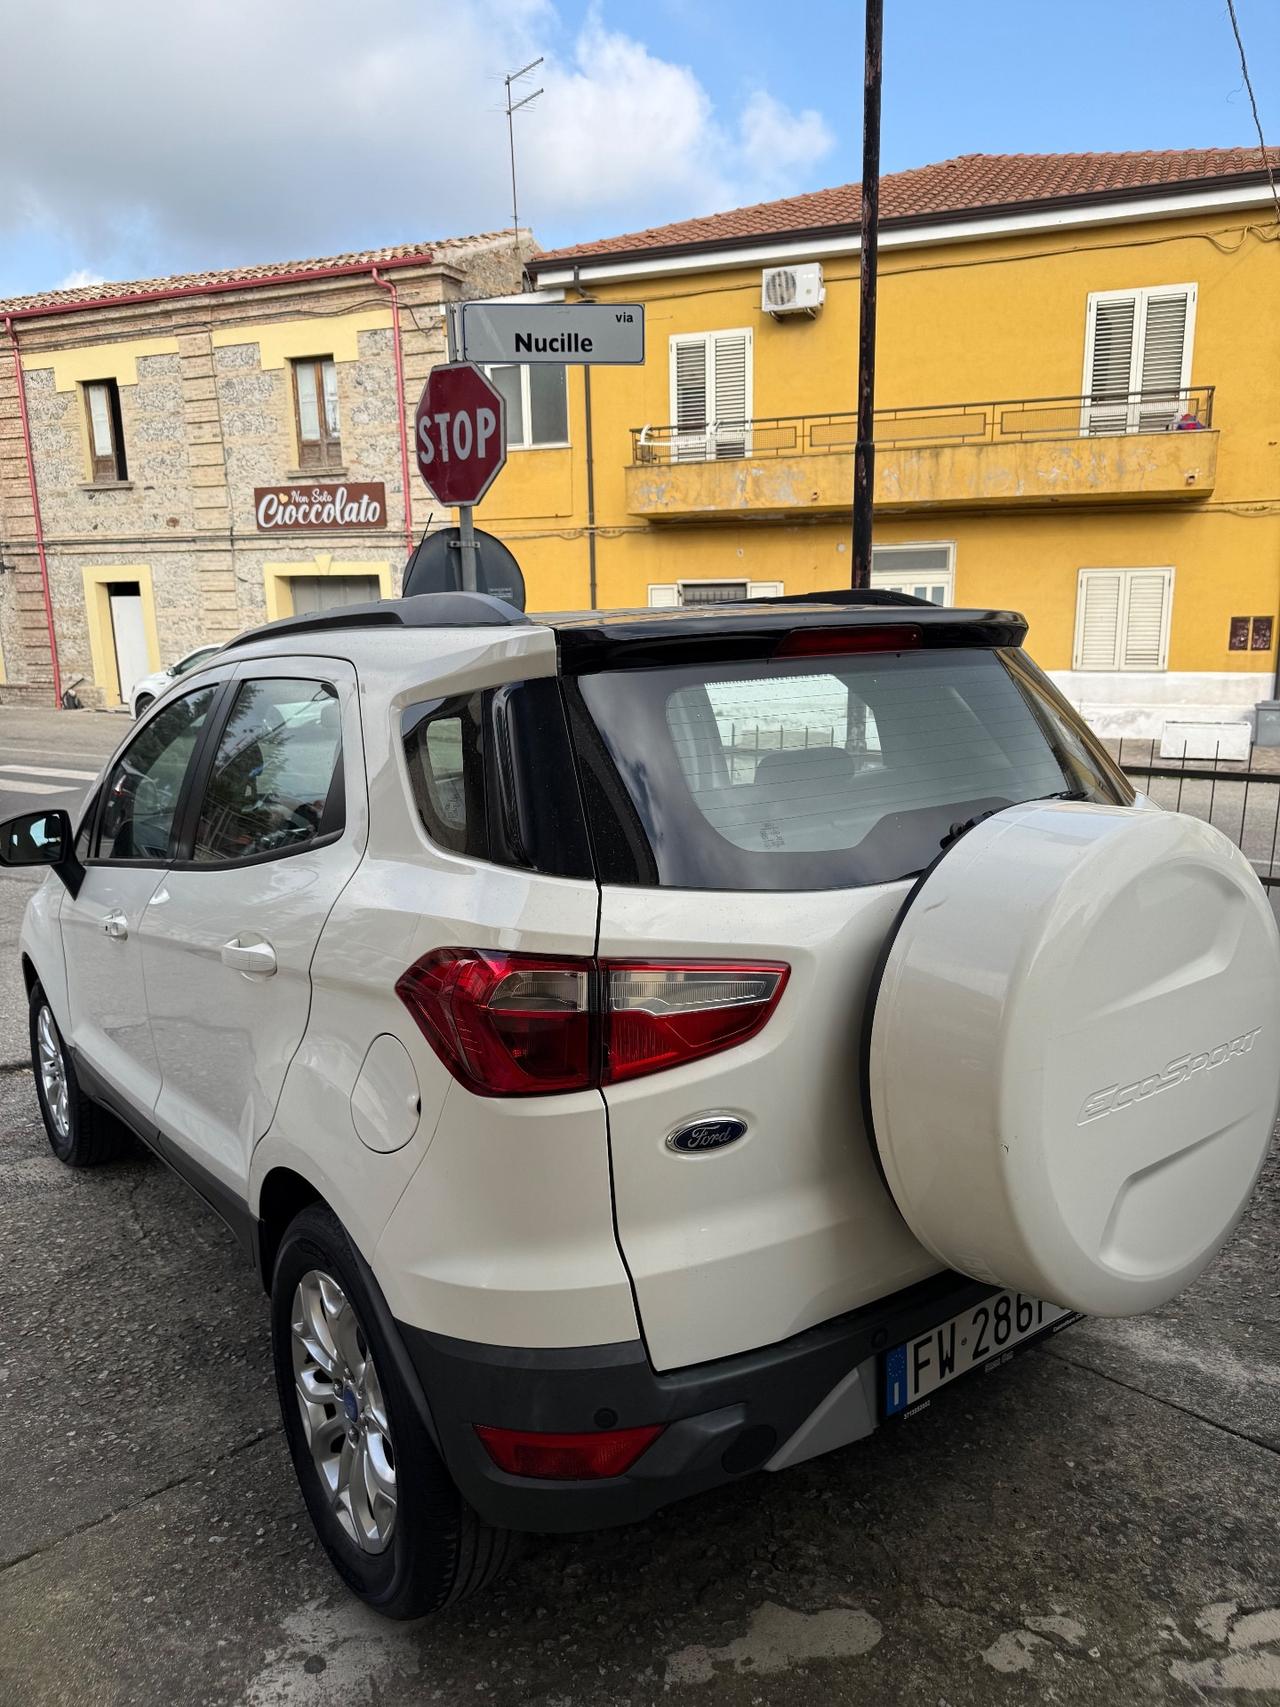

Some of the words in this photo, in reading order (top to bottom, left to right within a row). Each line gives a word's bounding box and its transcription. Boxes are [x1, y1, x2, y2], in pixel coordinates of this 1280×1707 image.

[615, 311, 634, 323] via
[514, 332, 593, 353] Nucille
[418, 407, 497, 465] STOP
[257, 486, 381, 528] Cioccolato
[290, 489, 309, 504] Non
[311, 488, 333, 503] Solo
[687, 1124, 732, 1148] Ford
